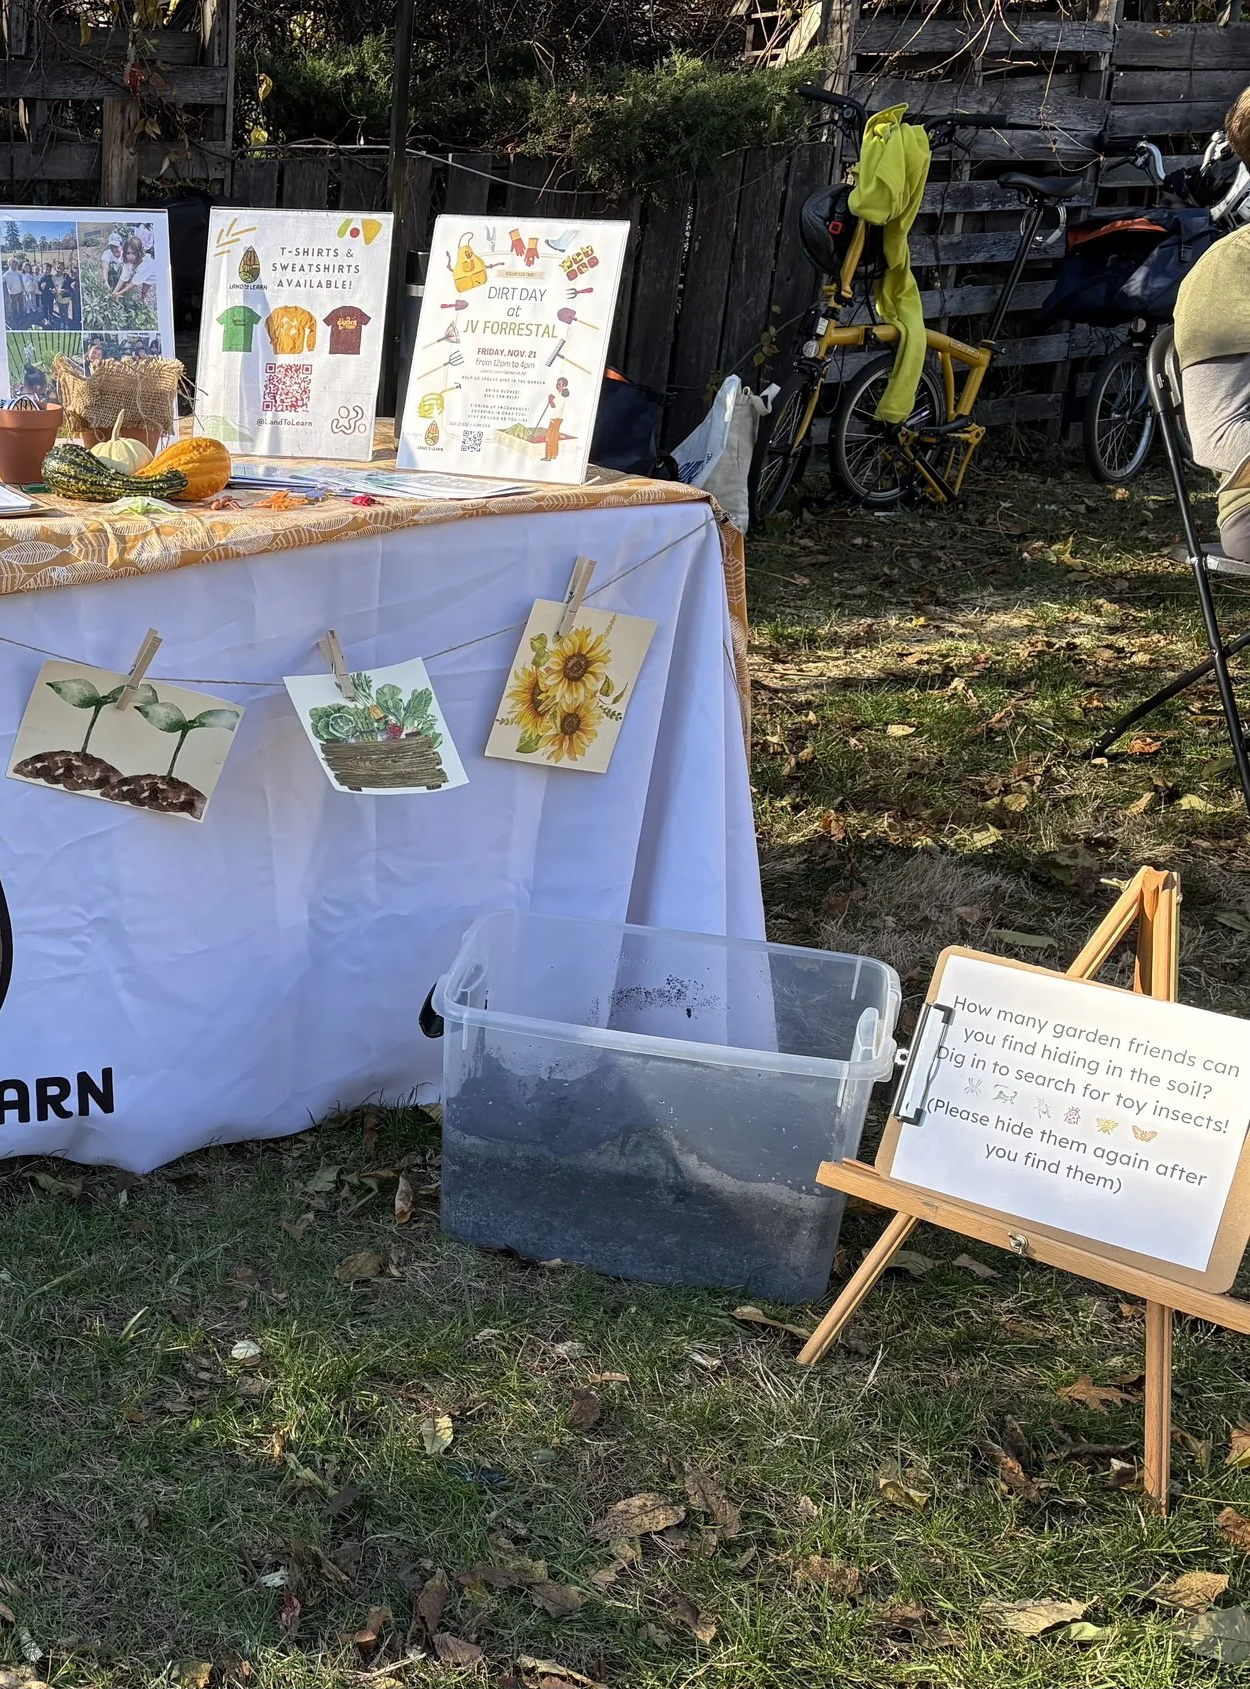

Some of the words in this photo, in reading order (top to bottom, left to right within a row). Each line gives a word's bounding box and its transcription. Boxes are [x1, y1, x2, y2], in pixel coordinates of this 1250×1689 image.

[280, 247, 339, 258] T-SHIRTS
[346, 248, 354, 258] &
[271, 262, 360, 274] SWEATSHIRTS
[277, 279, 352, 290] AVAILABLE!
[488, 286, 518, 300] DIRT
[520, 288, 547, 301] DAY
[506, 305, 522, 317] at
[463, 320, 480, 333] JV
[482, 321, 558, 338] FORRESTAL
[528, 350, 537, 358] 21
[476, 359, 492, 367] from
[494, 359, 511, 369] 12pm
[512, 360, 520, 368] to
[521, 360, 535, 370] 4pm
[953, 995, 993, 1017] How
[996, 1006, 1049, 1033] many
[1052, 1021, 1122, 1050] garden
[1127, 1037, 1198, 1067] friends
[1202, 1059, 1240, 1078] can
[963, 1026, 997, 1047] you
[1001, 1034, 1046, 1057] find
[1041, 1045, 1100, 1076] hiding
[1106, 1059, 1124, 1077] in
[1129, 1066, 1161, 1088] the
[1167, 1077, 1213, 1100] soil?
[936, 1045, 966, 1069] Dig
[970, 1053, 987, 1071] in
[992, 1060, 1010, 1077] to
[1014, 1067, 1076, 1095] search
[1083, 1082, 1111, 1102] for
[1115, 1092, 1147, 1116] toy
[1152, 1099, 1230, 1134] insects!
[926, 1097, 989, 1127] (Please
[994, 1116, 1033, 1140] hide
[1039, 1128, 1088, 1154] them
[1093, 1144, 1150, 1172] again
[1155, 1160, 1209, 1187] after
[984, 1142, 1018, 1163] you
[1023, 1151, 1060, 1175] find
[1066, 1164, 1124, 1195] them)
